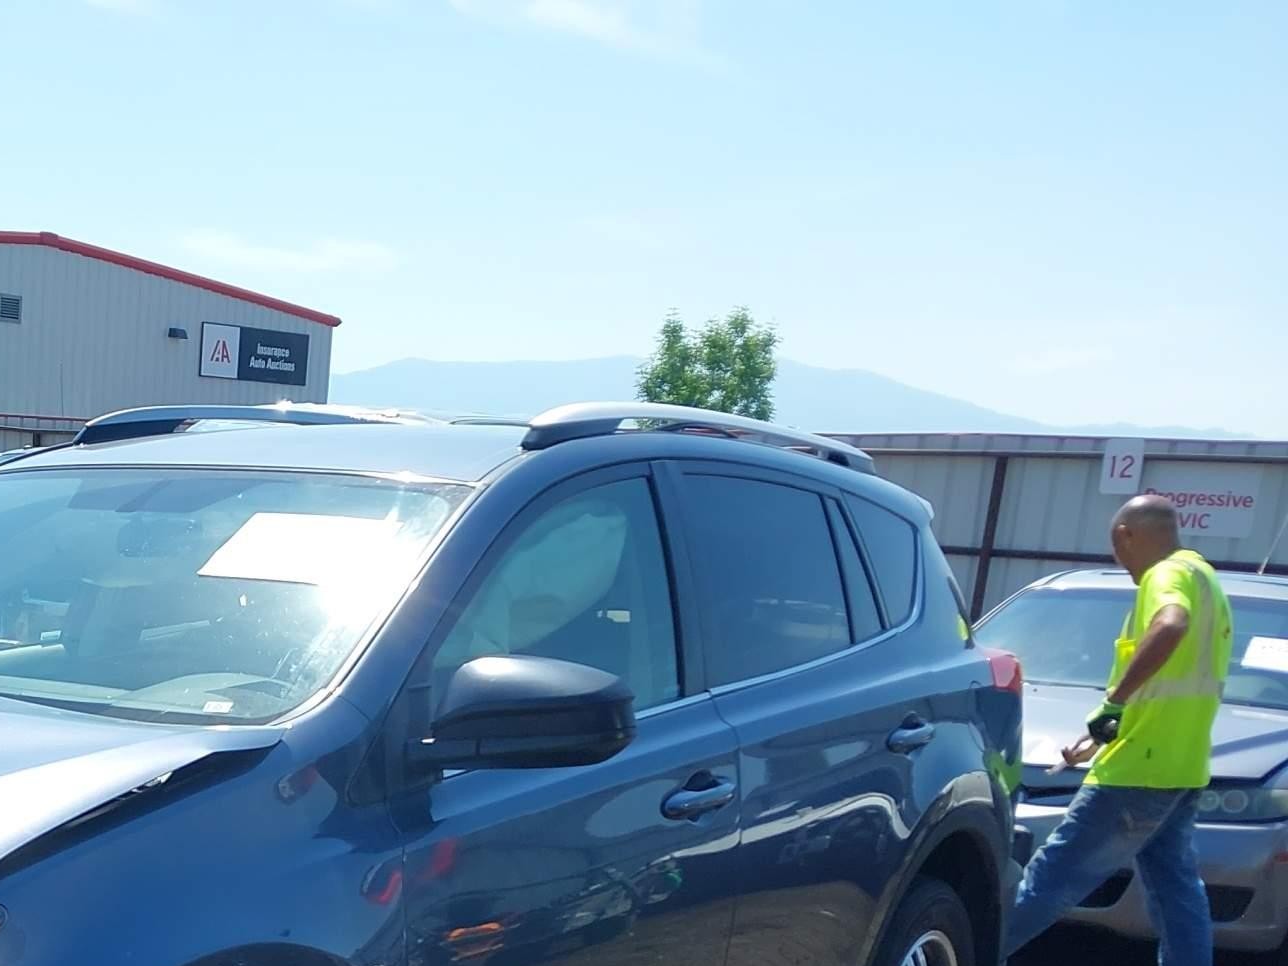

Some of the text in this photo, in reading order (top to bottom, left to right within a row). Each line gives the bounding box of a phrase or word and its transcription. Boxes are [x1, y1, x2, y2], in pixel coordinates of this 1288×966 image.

[249, 356, 296, 372] Auto Auctions
[1110, 455, 1135, 479] 12
